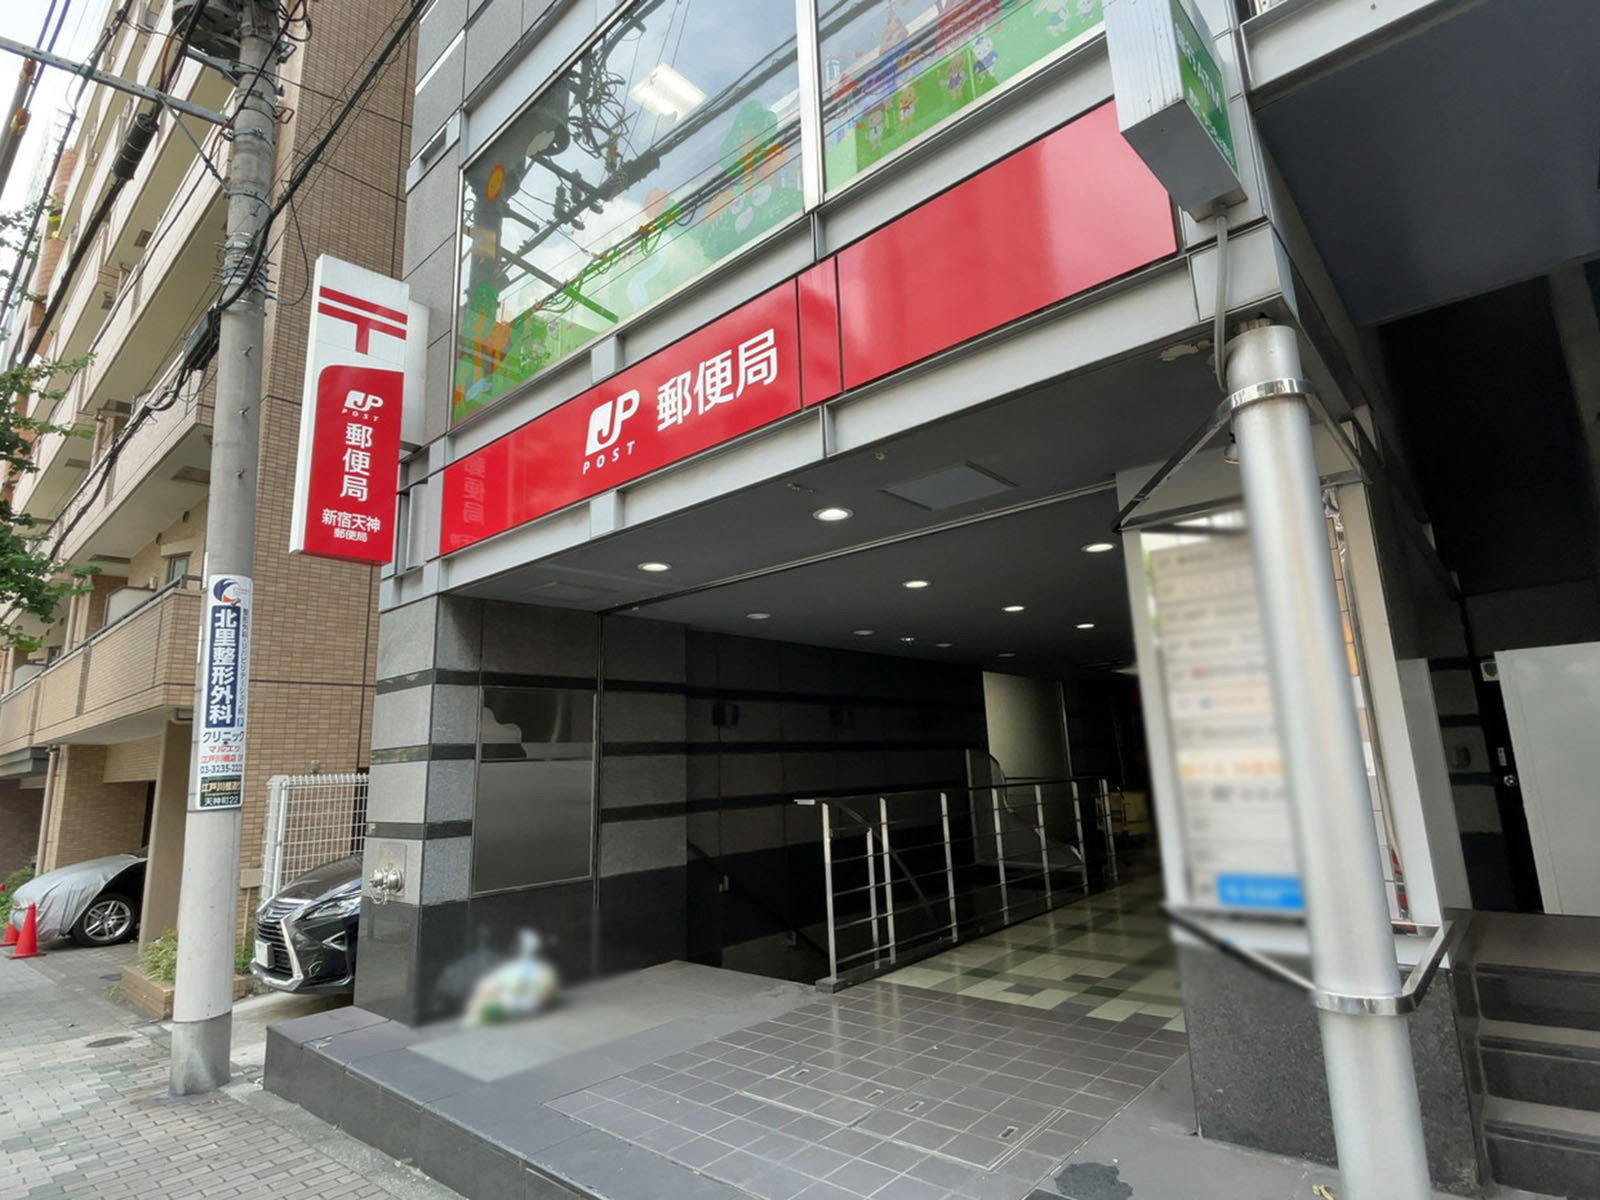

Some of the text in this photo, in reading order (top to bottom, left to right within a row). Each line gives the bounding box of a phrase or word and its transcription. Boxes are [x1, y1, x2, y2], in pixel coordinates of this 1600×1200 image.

[656, 328, 778, 432] 郵便局
[341, 408, 379, 422] POST
[339, 422, 373, 502] 郵便局
[582, 440, 635, 475] POST
[321, 508, 381, 532] 新宿天神
[333, 527, 368, 542] 郵便局
[209, 609, 237, 724] 北里整形外科
